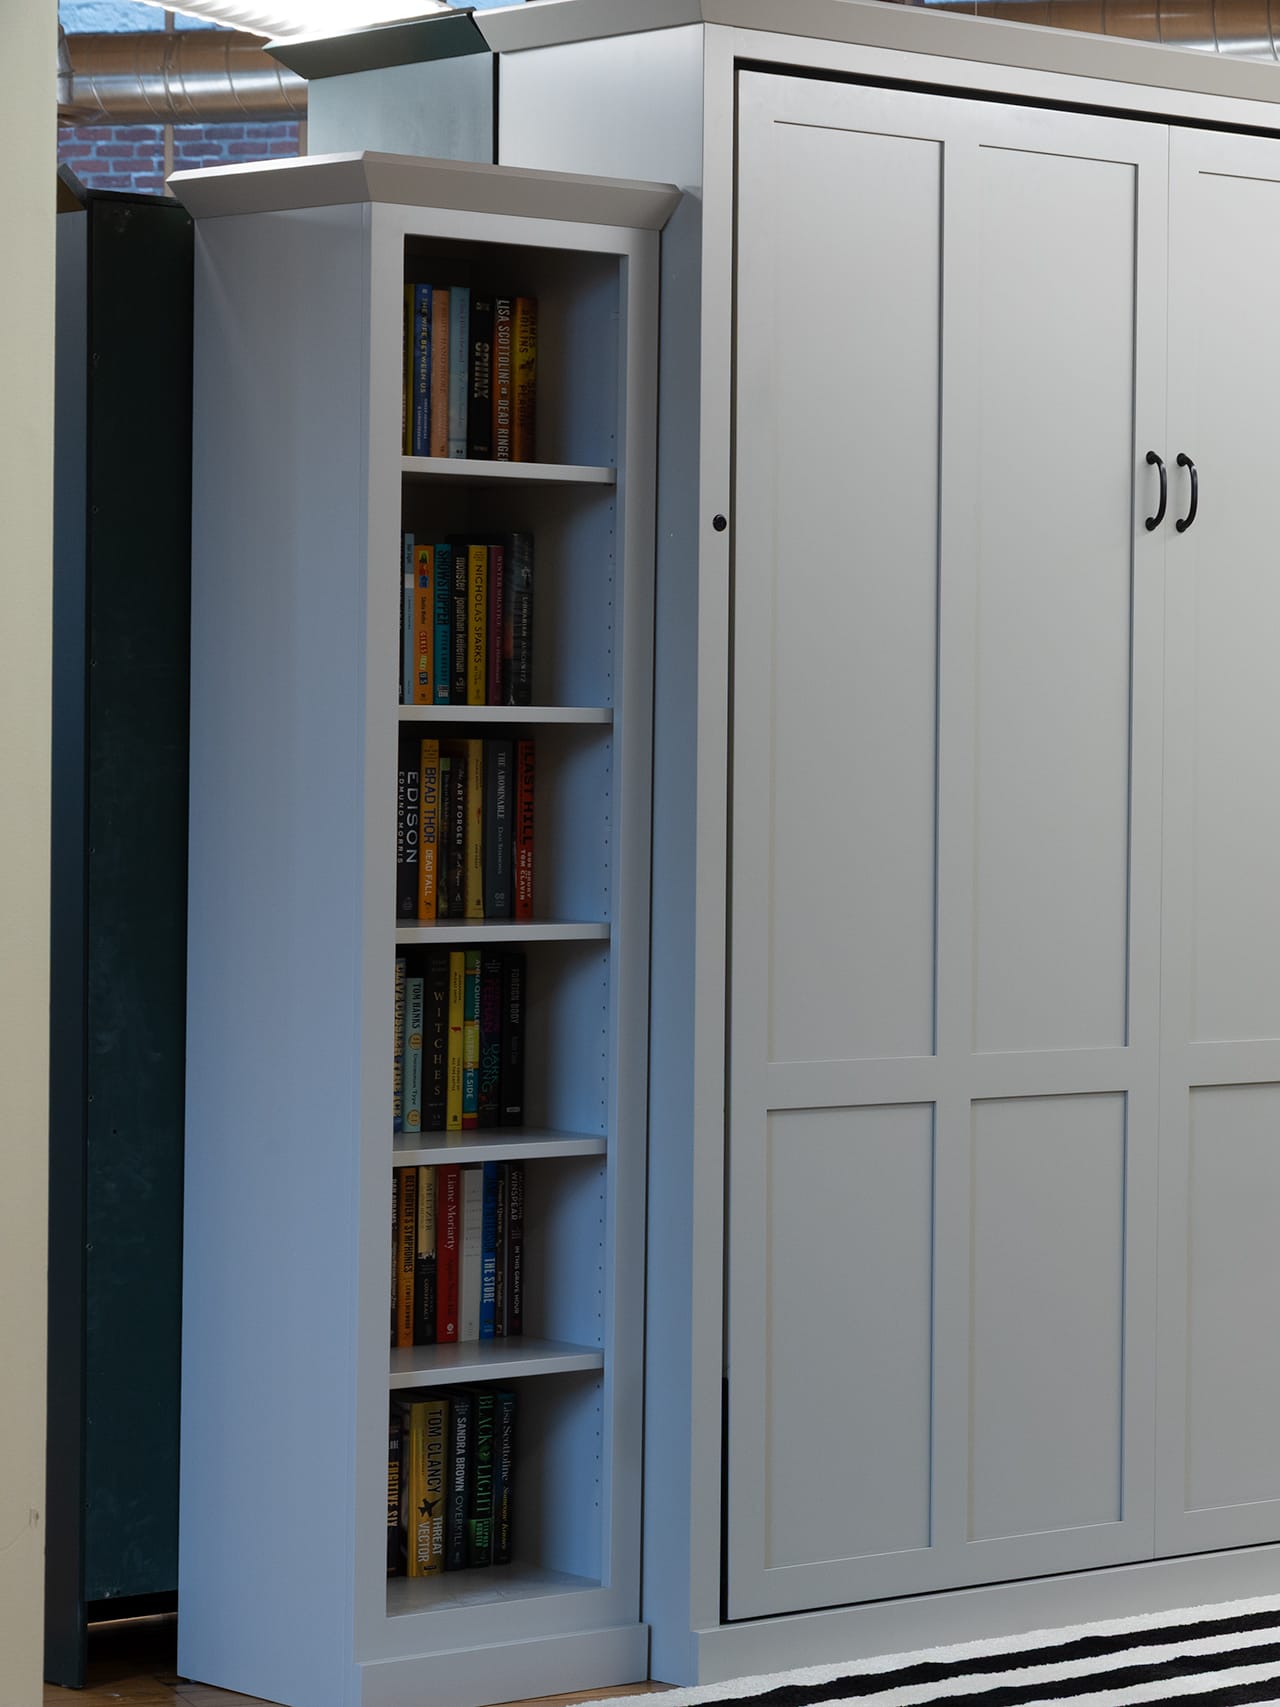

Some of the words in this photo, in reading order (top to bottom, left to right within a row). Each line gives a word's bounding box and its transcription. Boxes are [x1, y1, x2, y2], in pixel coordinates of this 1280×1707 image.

[497, 299, 510, 322] LISA
[474, 342, 489, 400] SPHINX
[497, 325, 510, 384] SCOTTOLINE
[420, 382, 426, 393] US
[497, 399, 509, 424] DEAD
[437, 550, 449, 625] SHOWSTOPPER
[456, 557, 465, 591] monster
[474, 564, 482, 623] NICHOLAS
[454, 596, 465, 631] jonathan
[456, 634, 465, 672] kellerman
[474, 627, 482, 663] SPARKS
[498, 752, 506, 767] THE
[424, 768, 436, 804] BRAD
[497, 769, 505, 820] ABOMINABLE
[406, 771, 418, 863] EDISON
[424, 808, 436, 844] THOR
[523, 801, 533, 845] HILL
[425, 849, 433, 871] DEAD
[425, 875, 433, 896] FALL
[412, 983, 421, 1000] TOM
[510, 968, 519, 1001] FOREIGN
[412, 1002, 420, 1029] HANKS
[510, 1003, 519, 1024] BODY
[466, 1027, 474, 1078] ALTERNATE
[482, 1047, 492, 1093] SONG
[491, 1043, 501, 1083] DARK
[466, 1079, 474, 1099] SIDE
[405, 1175, 414, 1223] BEETHOVEN'S
[447, 1174, 457, 1203] Liane
[444, 1205, 456, 1250] Moriarty
[404, 1225, 414, 1273] SYMPHONIES
[484, 1258, 495, 1275] THE
[514, 1246, 520, 1254] IN
[483, 1276, 495, 1304] STORE
[428, 1410, 442, 1437] TOM
[478, 1395, 494, 1445] BLACK
[503, 1402, 512, 1424] Lisa
[456, 1417, 467, 1455] SANDRA
[501, 1426, 512, 1480] Scottoline
[428, 1443, 442, 1493] CLANCY
[455, 1457, 466, 1492] BROWN
[476, 1464, 492, 1514] LIGHT
[432, 1516, 443, 1555] THREAT
[454, 1495, 464, 1547] OVERKILL
[418, 1522, 430, 1562] VECTOR
